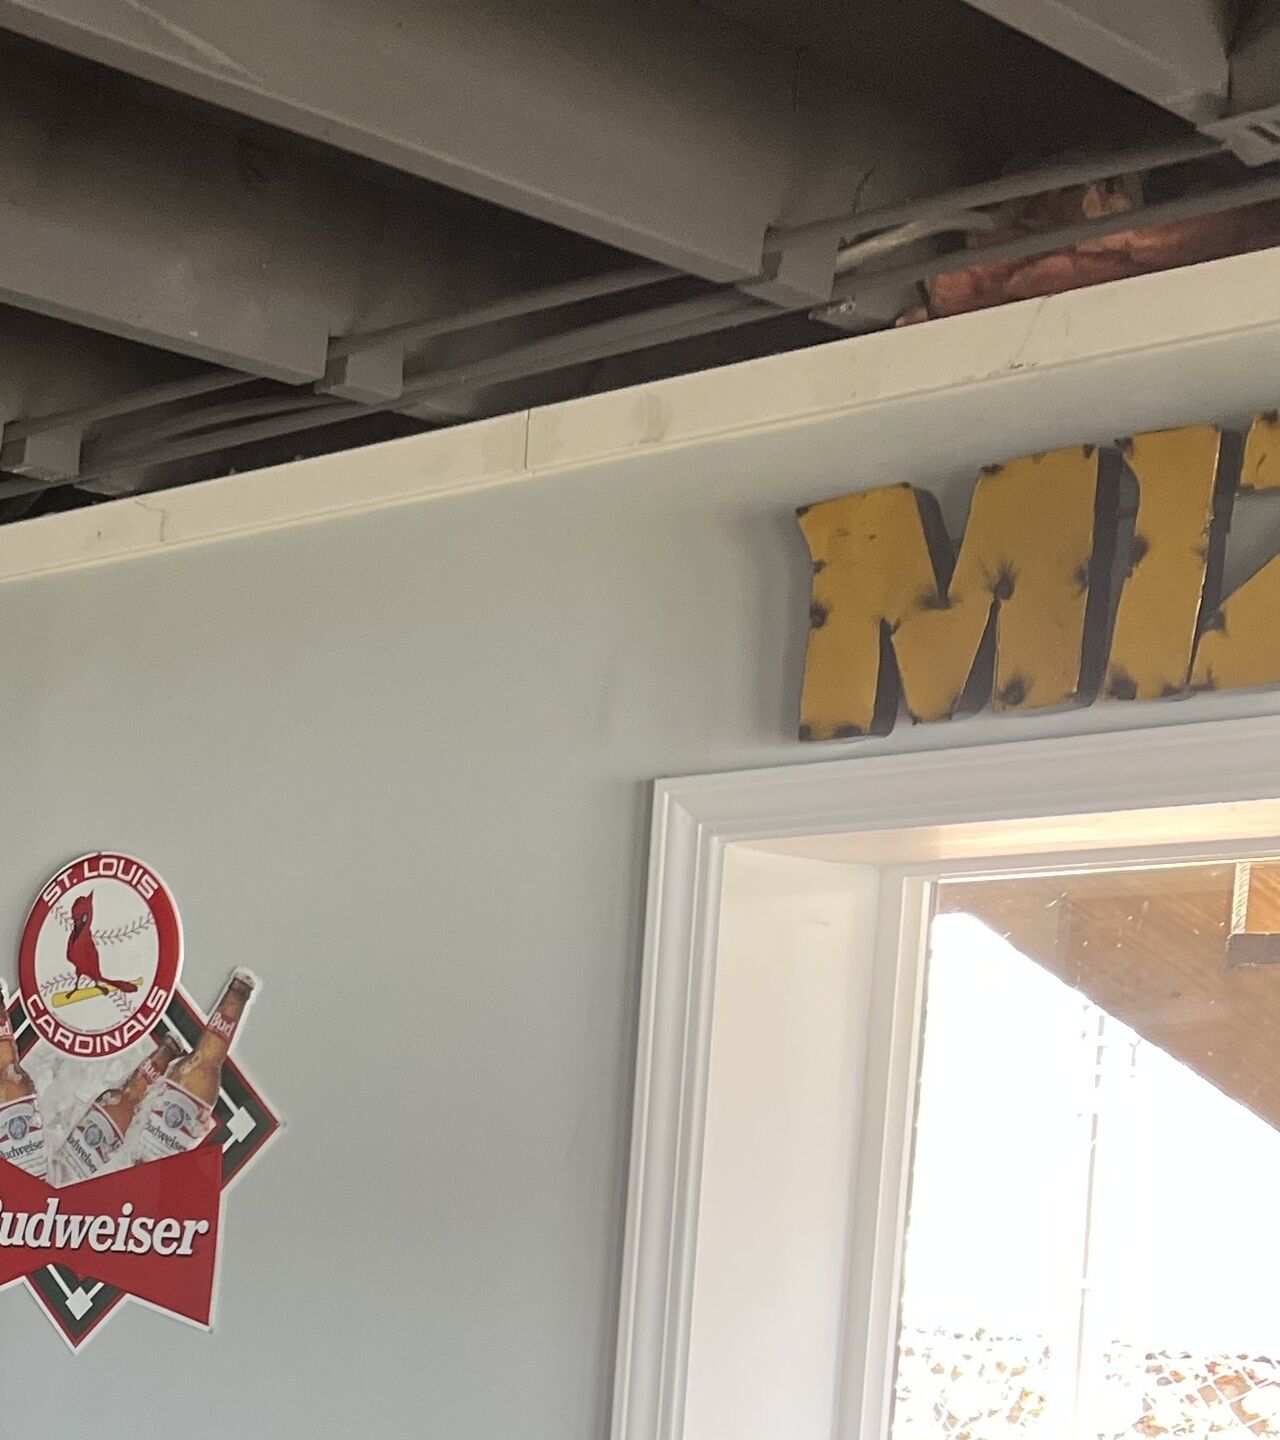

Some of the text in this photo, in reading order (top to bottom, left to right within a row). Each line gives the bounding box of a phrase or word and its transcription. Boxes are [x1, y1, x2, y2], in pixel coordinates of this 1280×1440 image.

[42, 858, 159, 907] ST. LOUIS
[24, 985, 167, 1055] CARDINALS
[210, 1012, 236, 1037] Bud
